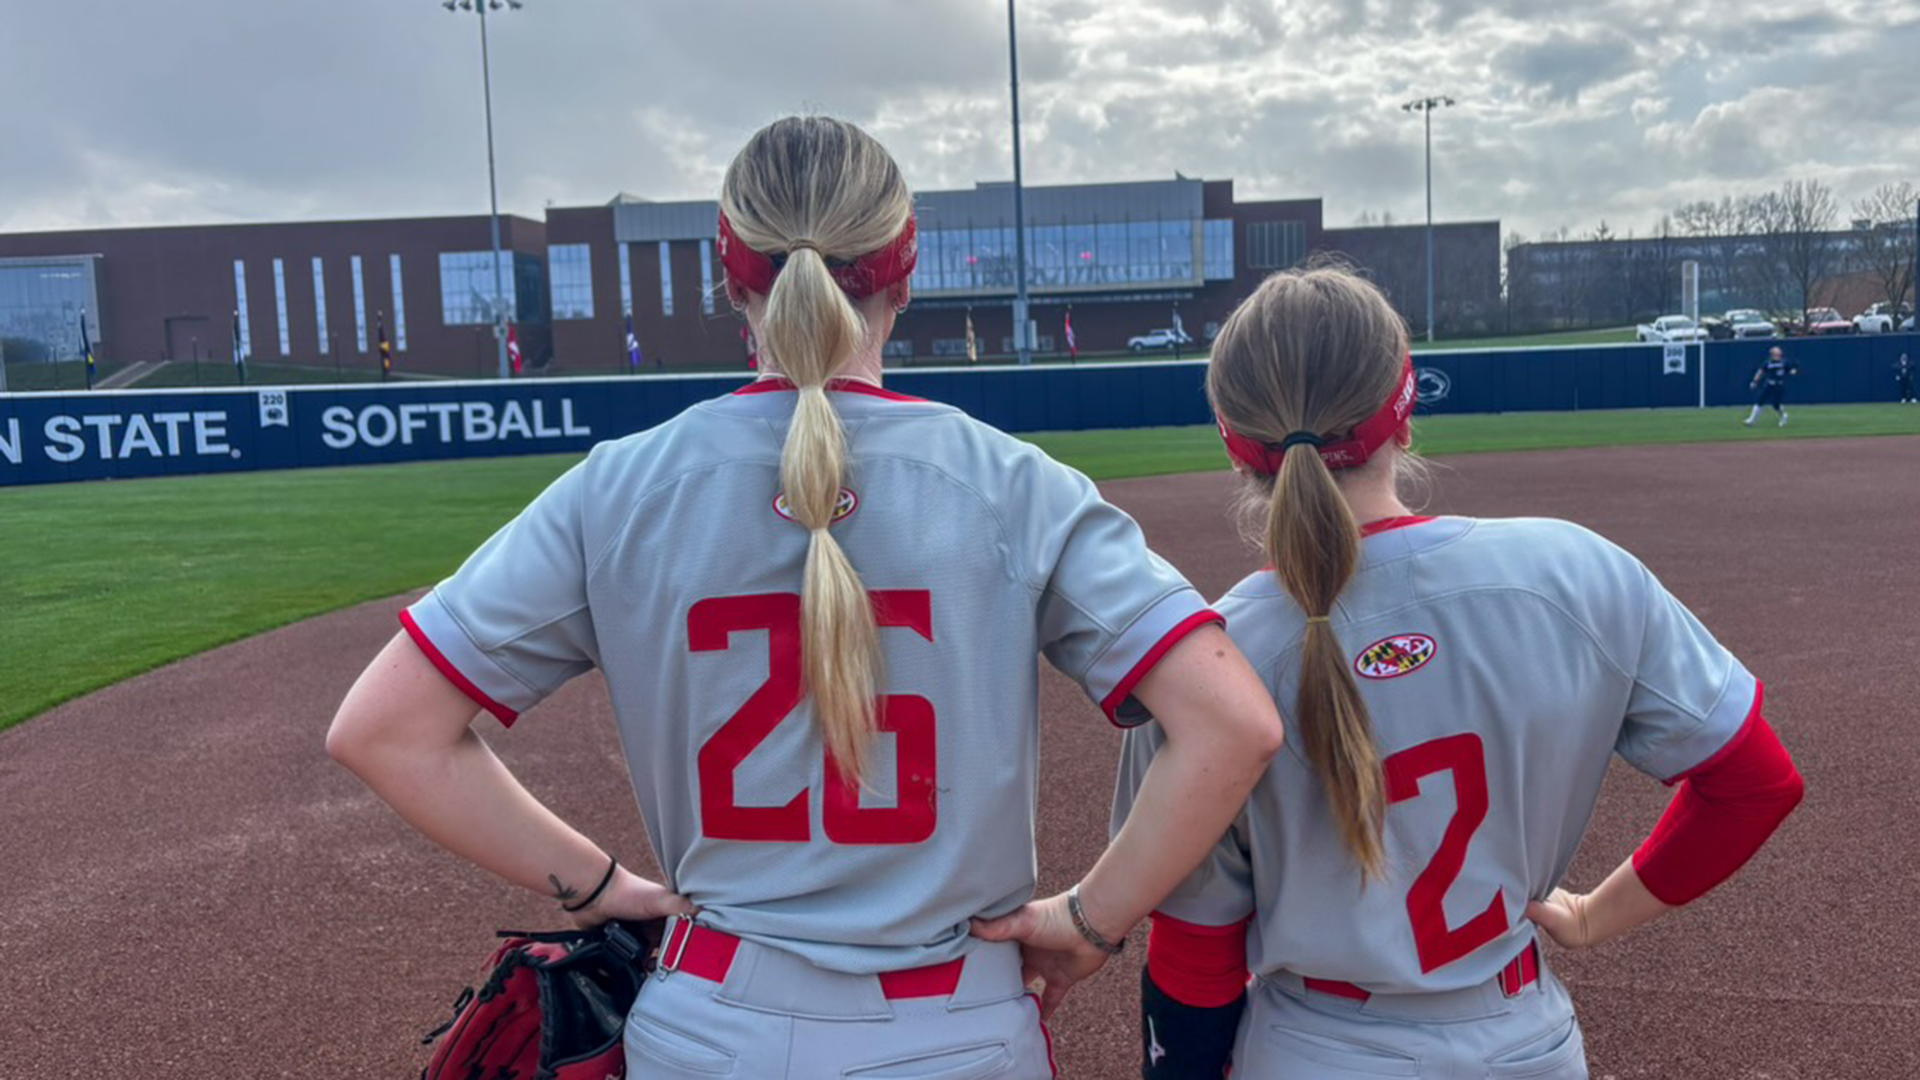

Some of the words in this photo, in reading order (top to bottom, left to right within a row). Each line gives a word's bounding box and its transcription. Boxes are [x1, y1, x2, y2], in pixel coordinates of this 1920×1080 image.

[262, 394, 284, 405] 220
[321, 398, 592, 449] SOFTBALL
[687, 588, 938, 845] 26
[1382, 732, 1509, 974] 2
